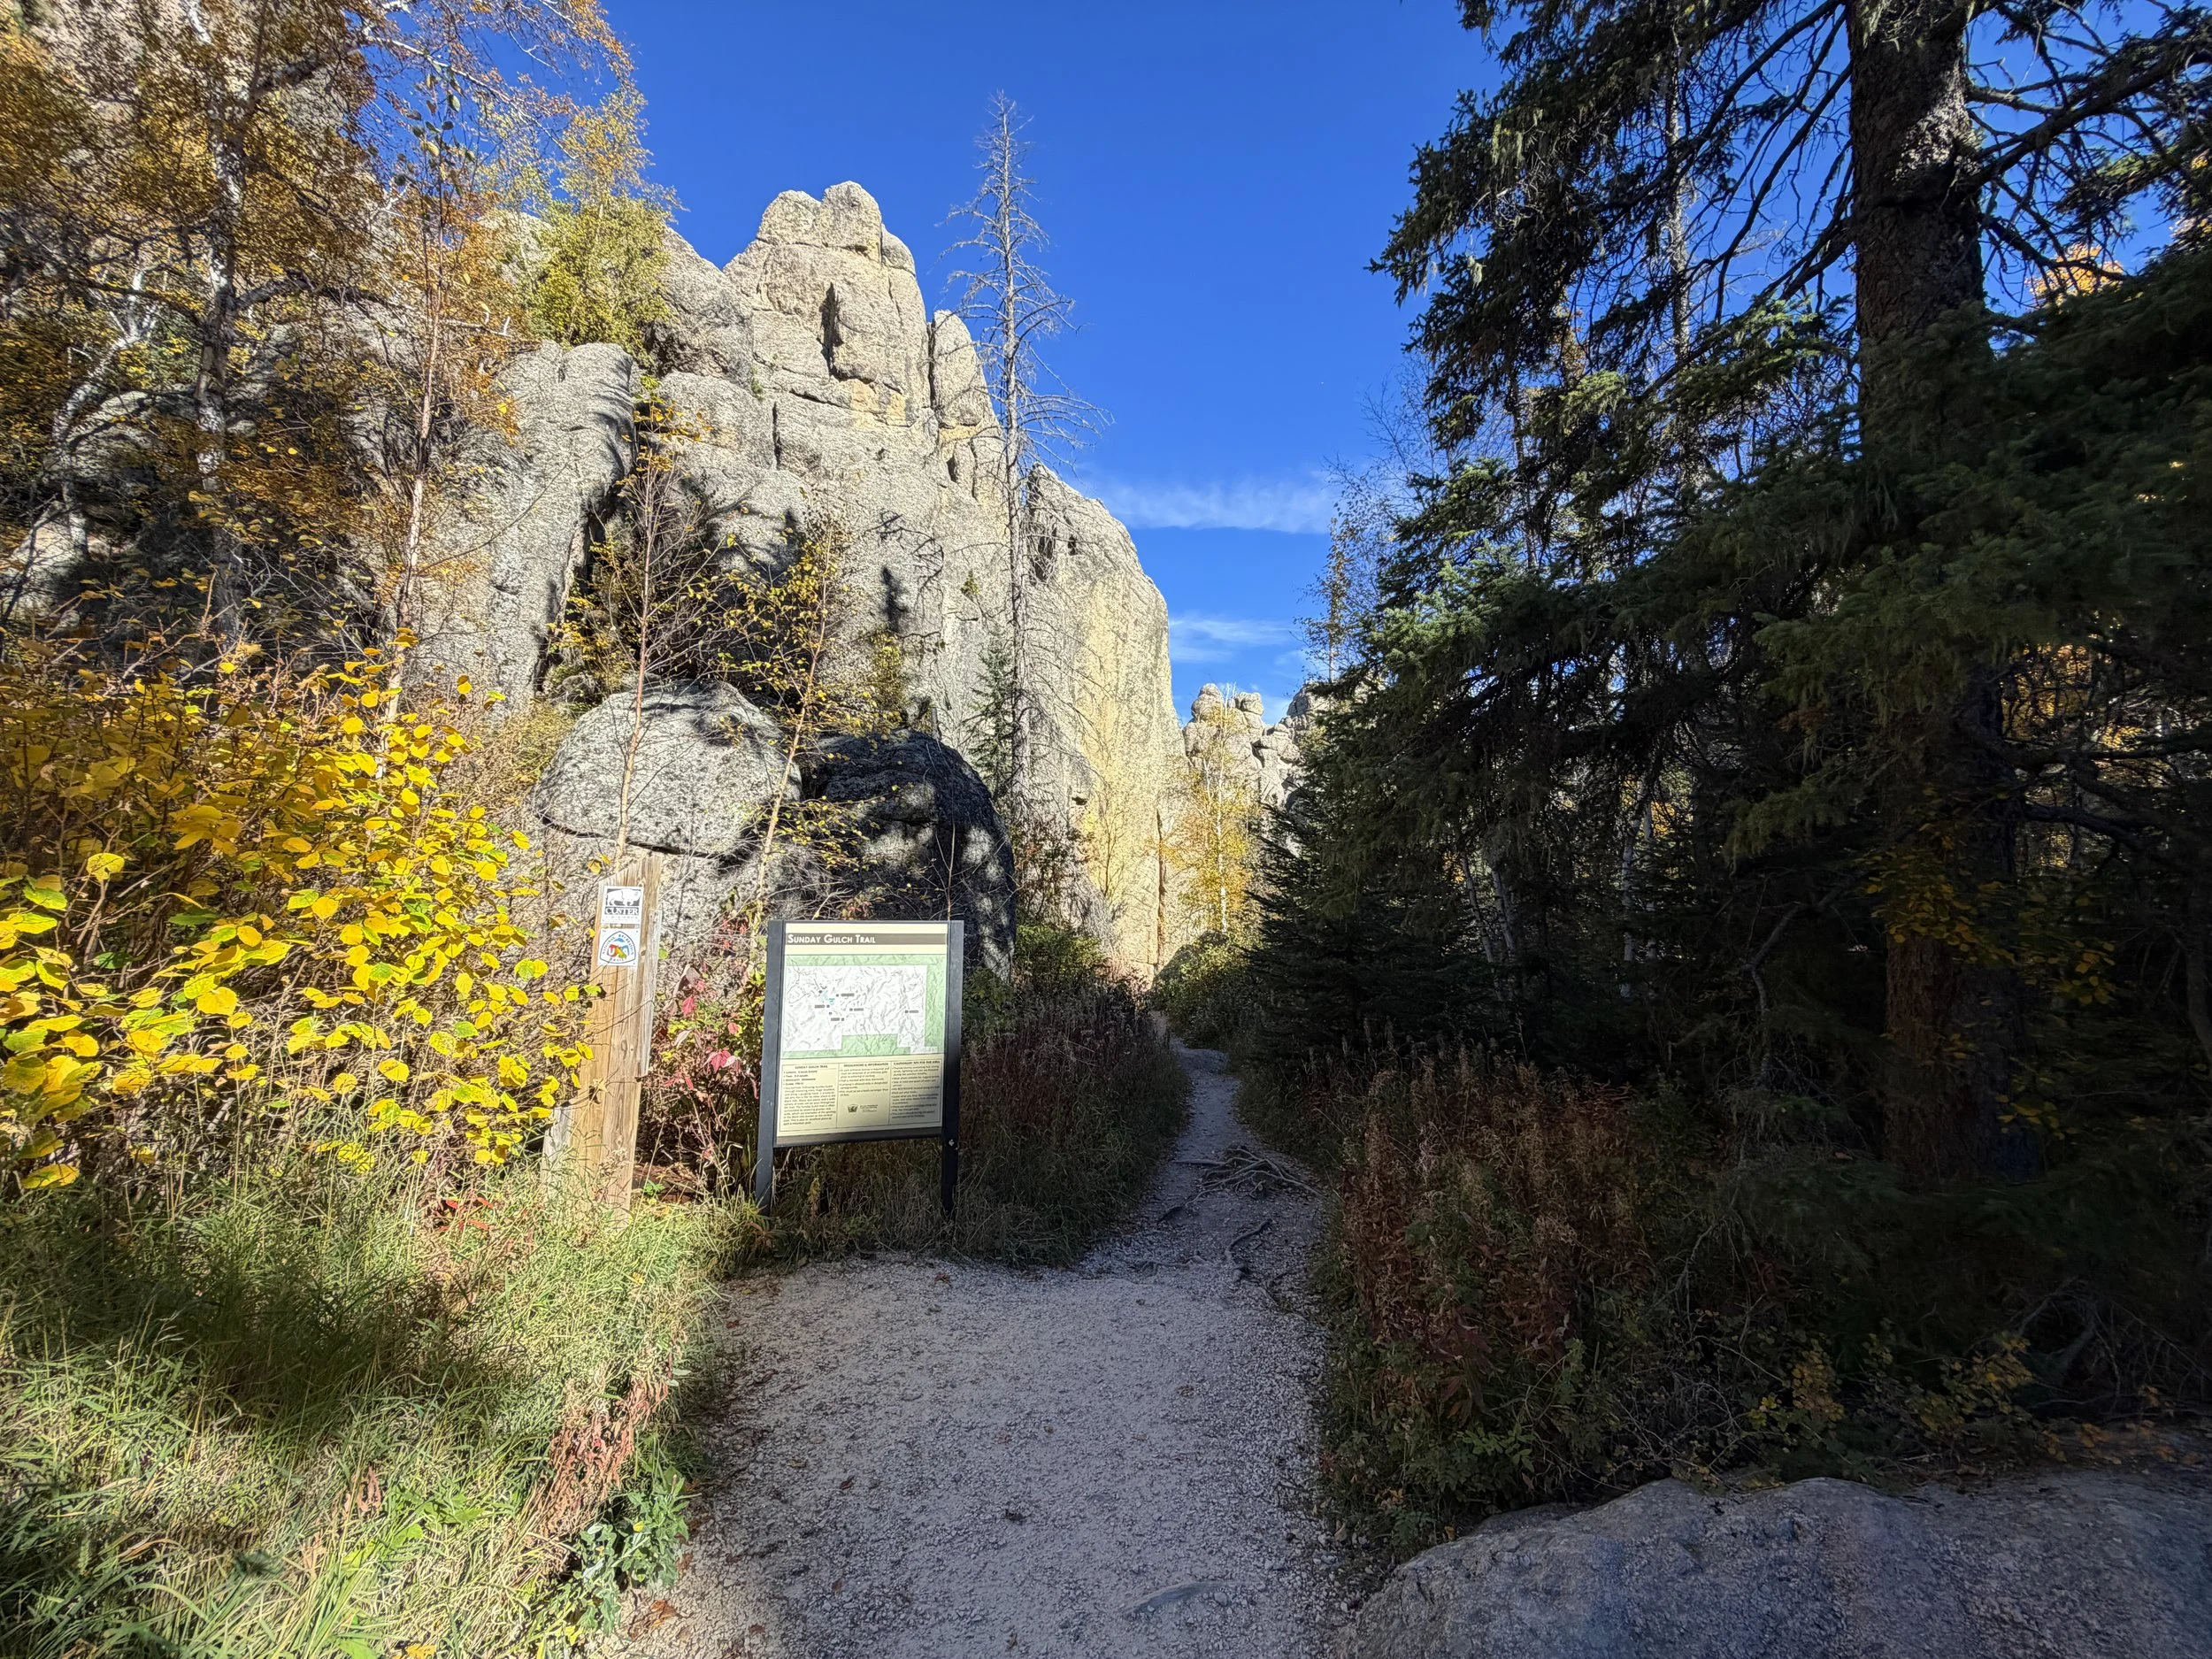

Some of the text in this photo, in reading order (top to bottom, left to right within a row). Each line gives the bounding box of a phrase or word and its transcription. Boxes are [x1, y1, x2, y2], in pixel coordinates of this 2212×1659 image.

[787, 934, 876, 943] SUNDAY GULCH TRAIL
